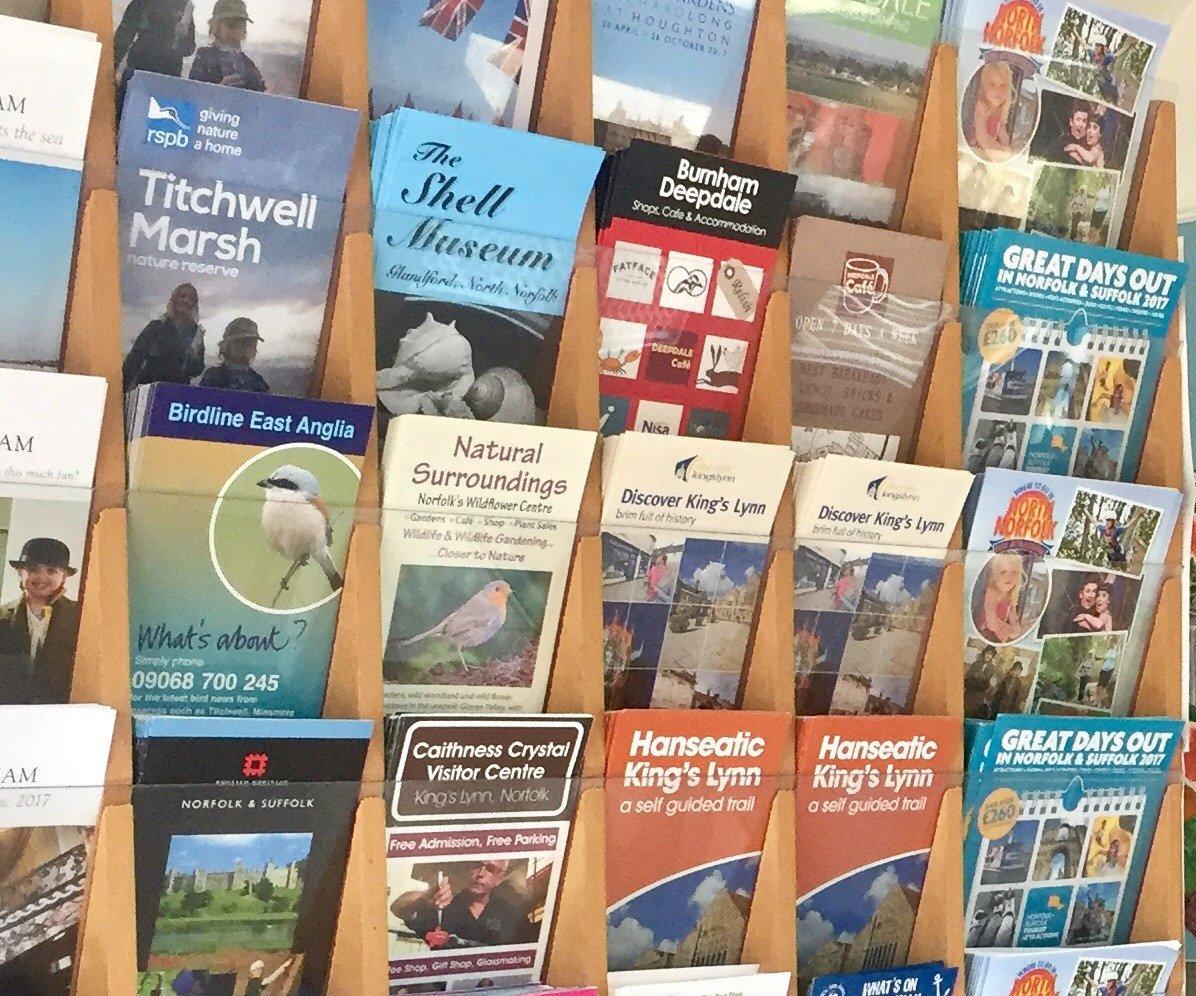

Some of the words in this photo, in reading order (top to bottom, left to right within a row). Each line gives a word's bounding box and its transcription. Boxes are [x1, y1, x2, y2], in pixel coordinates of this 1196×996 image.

[199, 108, 240, 127] giving
[147, 129, 188, 149] rspb
[197, 124, 239, 140] nature
[205, 141, 242, 156] home
[413, 142, 462, 168] The
[677, 158, 760, 197] Burnham
[138, 168, 318, 229] Titchwell
[401, 172, 515, 218] Shell
[659, 176, 753, 215] Deepdale
[129, 212, 262, 263] Marsh
[386, 216, 554, 272] Museum
[127, 254, 179, 272] nature
[181, 259, 240, 279] reserve
[1003, 244, 1078, 280] GREAT
[1076, 258, 1128, 288] DAYS
[1128, 268, 1178, 296] OUT
[997, 269, 1014, 284] IN
[1015, 273, 1077, 297] NORFOLK
[1079, 284, 1089, 297] &
[1091, 284, 1143, 307] SUFFOLK
[1142, 294, 1170, 310] 2017
[168, 402, 245, 428] Birdline
[250, 411, 292, 432] East
[296, 416, 356, 441] Anglia
[642, 420, 670, 435] Nisa
[453, 435, 544, 464] Natural
[412, 462, 568, 500] Surroundings
[418, 493, 464, 508] Norfolk's
[466, 497, 518, 513] Wildflower
[519, 501, 553, 514] Centre
[621, 488, 683, 509] Discover
[685, 493, 730, 516] King's
[734, 497, 767, 517] Lynn
[818, 505, 873, 525] Discover
[873, 510, 912, 531] King's
[915, 515, 946, 534] Lynn
[437, 548, 472, 560] Closer
[475, 551, 486, 560] to
[488, 550, 525, 563] Nature
[137, 618, 210, 651] What's
[216, 618, 307, 652] about?
[132, 671, 194, 690] 09068
[202, 672, 238, 691] 700
[243, 674, 280, 692] 245
[412, 741, 502, 760] Caithness
[508, 741, 570, 761] Crystal
[629, 730, 765, 758] Hanseatic
[818, 734, 938, 761] Hanseatic
[1001, 729, 1074, 751] GREAT
[1072, 730, 1124, 752] DAYS
[1126, 731, 1174, 752] OUT
[995, 752, 1011, 765] IN
[1012, 753, 1074, 765] NORFOLK
[1075, 753, 1084, 765] &
[1086, 752, 1138, 766] SUFFOLK
[1139, 753, 1166, 766] 2017
[1, 766, 39, 785] AM
[427, 765, 481, 782] Visitor
[484, 764, 545, 780] Centre
[623, 761, 701, 795] King's
[706, 762, 762, 793] Lynn
[812, 764, 879, 795] King's
[884, 764, 934, 793] Lynn
[181, 798, 243, 810] NORFOLK
[260, 798, 315, 808] SUFFOLK
[619, 800, 632, 814] a
[635, 796, 664, 813] self
[665, 796, 723, 817] guided
[726, 794, 756, 812] trail
[808, 801, 818, 813] a
[821, 797, 846, 813] self
[848, 796, 899, 816] guided
[901, 794, 928, 811] trail
[389, 838, 416, 851] Free
[419, 835, 482, 850] Admission,
[487, 834, 512, 847] Free
[514, 832, 557, 847] Parking
[862, 977, 900, 996] WHAT'S
[902, 977, 918, 992] ON
